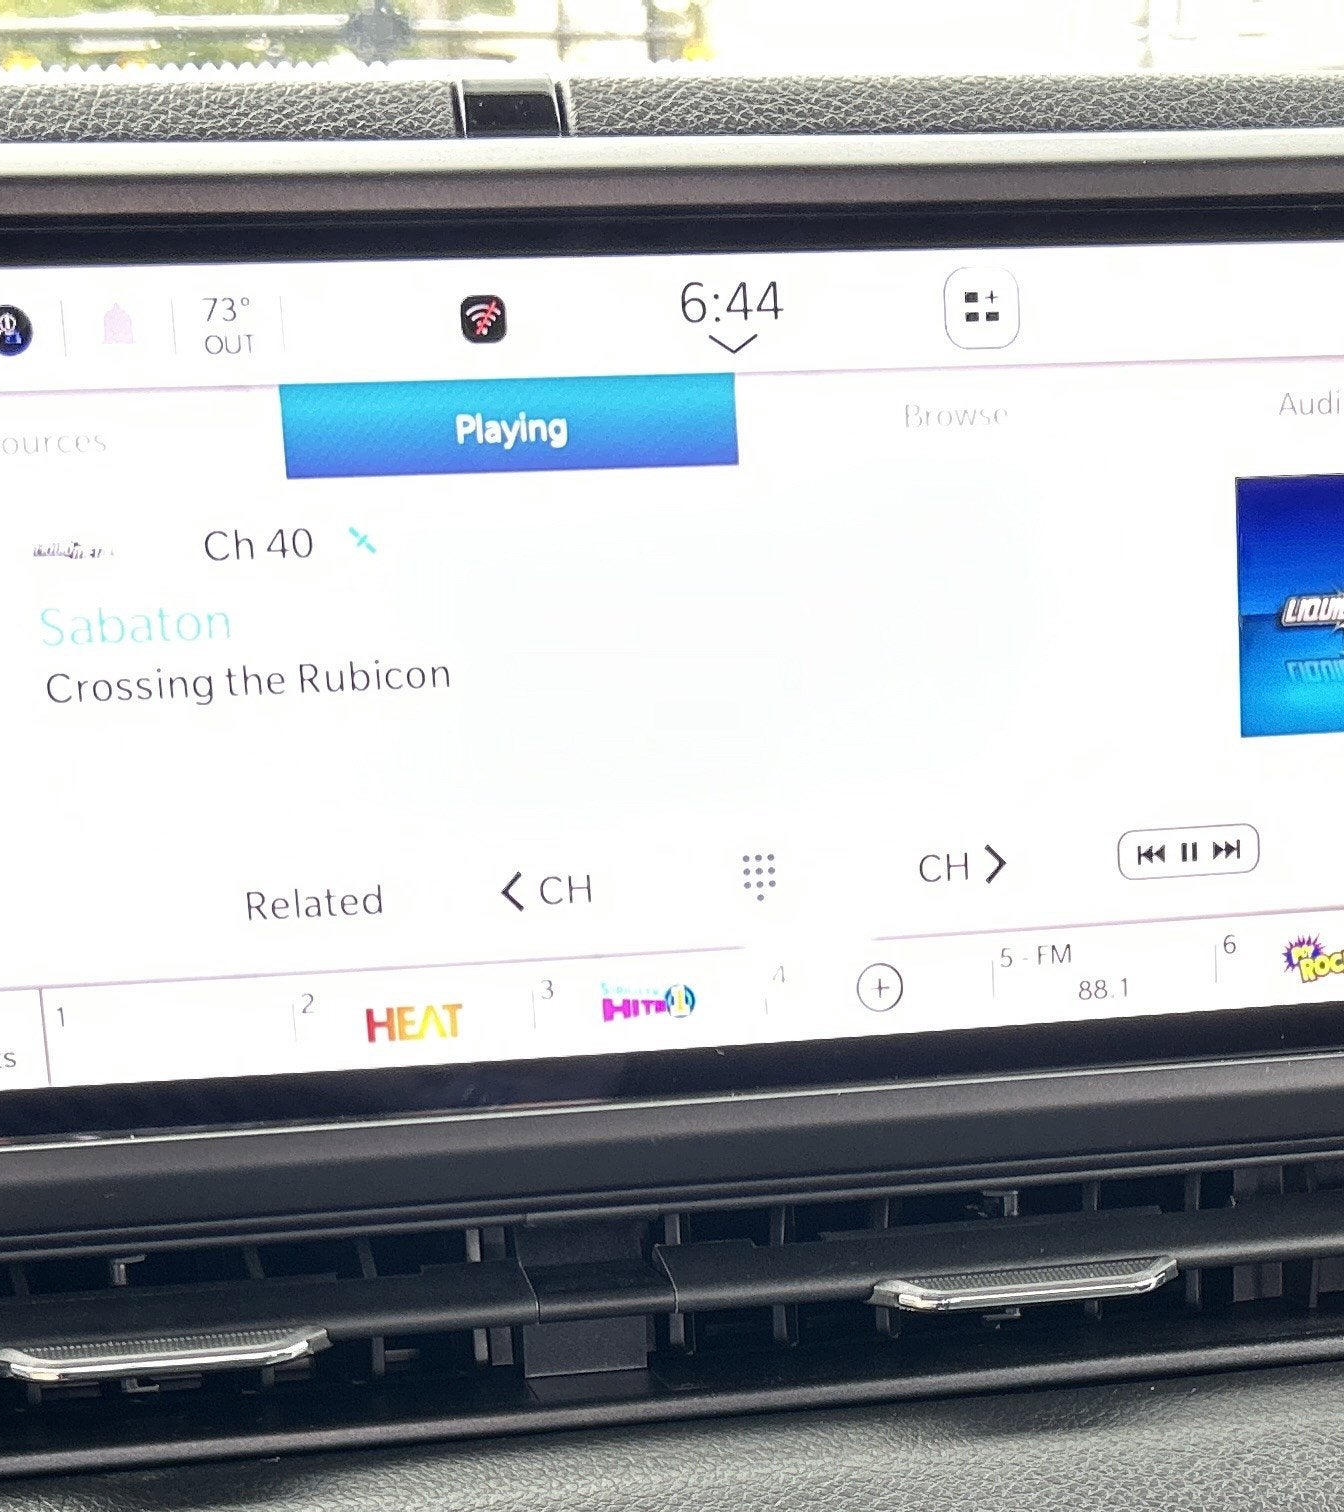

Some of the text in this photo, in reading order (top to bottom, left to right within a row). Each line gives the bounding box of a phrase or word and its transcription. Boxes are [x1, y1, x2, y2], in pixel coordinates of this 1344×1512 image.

[680, 280, 784, 324] 6:44
[204, 333, 254, 356] OUT
[456, 411, 567, 449] Playing
[904, 403, 1008, 430] Browse
[203, 527, 314, 561] Ch 40
[41, 605, 232, 649] Sabaton
[46, 656, 452, 708] Crossing the Rubicon
[918, 852, 969, 884] CH
[246, 884, 385, 921] Related
[540, 873, 593, 905] CH
[1000, 947, 1013, 968] 5
[1037, 943, 1072, 966] FM
[1223, 934, 1237, 955] 6
[300, 992, 316, 1014] 2
[540, 979, 555, 1001] 3
[1078, 977, 1129, 1000] 88.1
[56, 1006, 65, 1028] 1
[365, 1003, 463, 1043] HEAT
